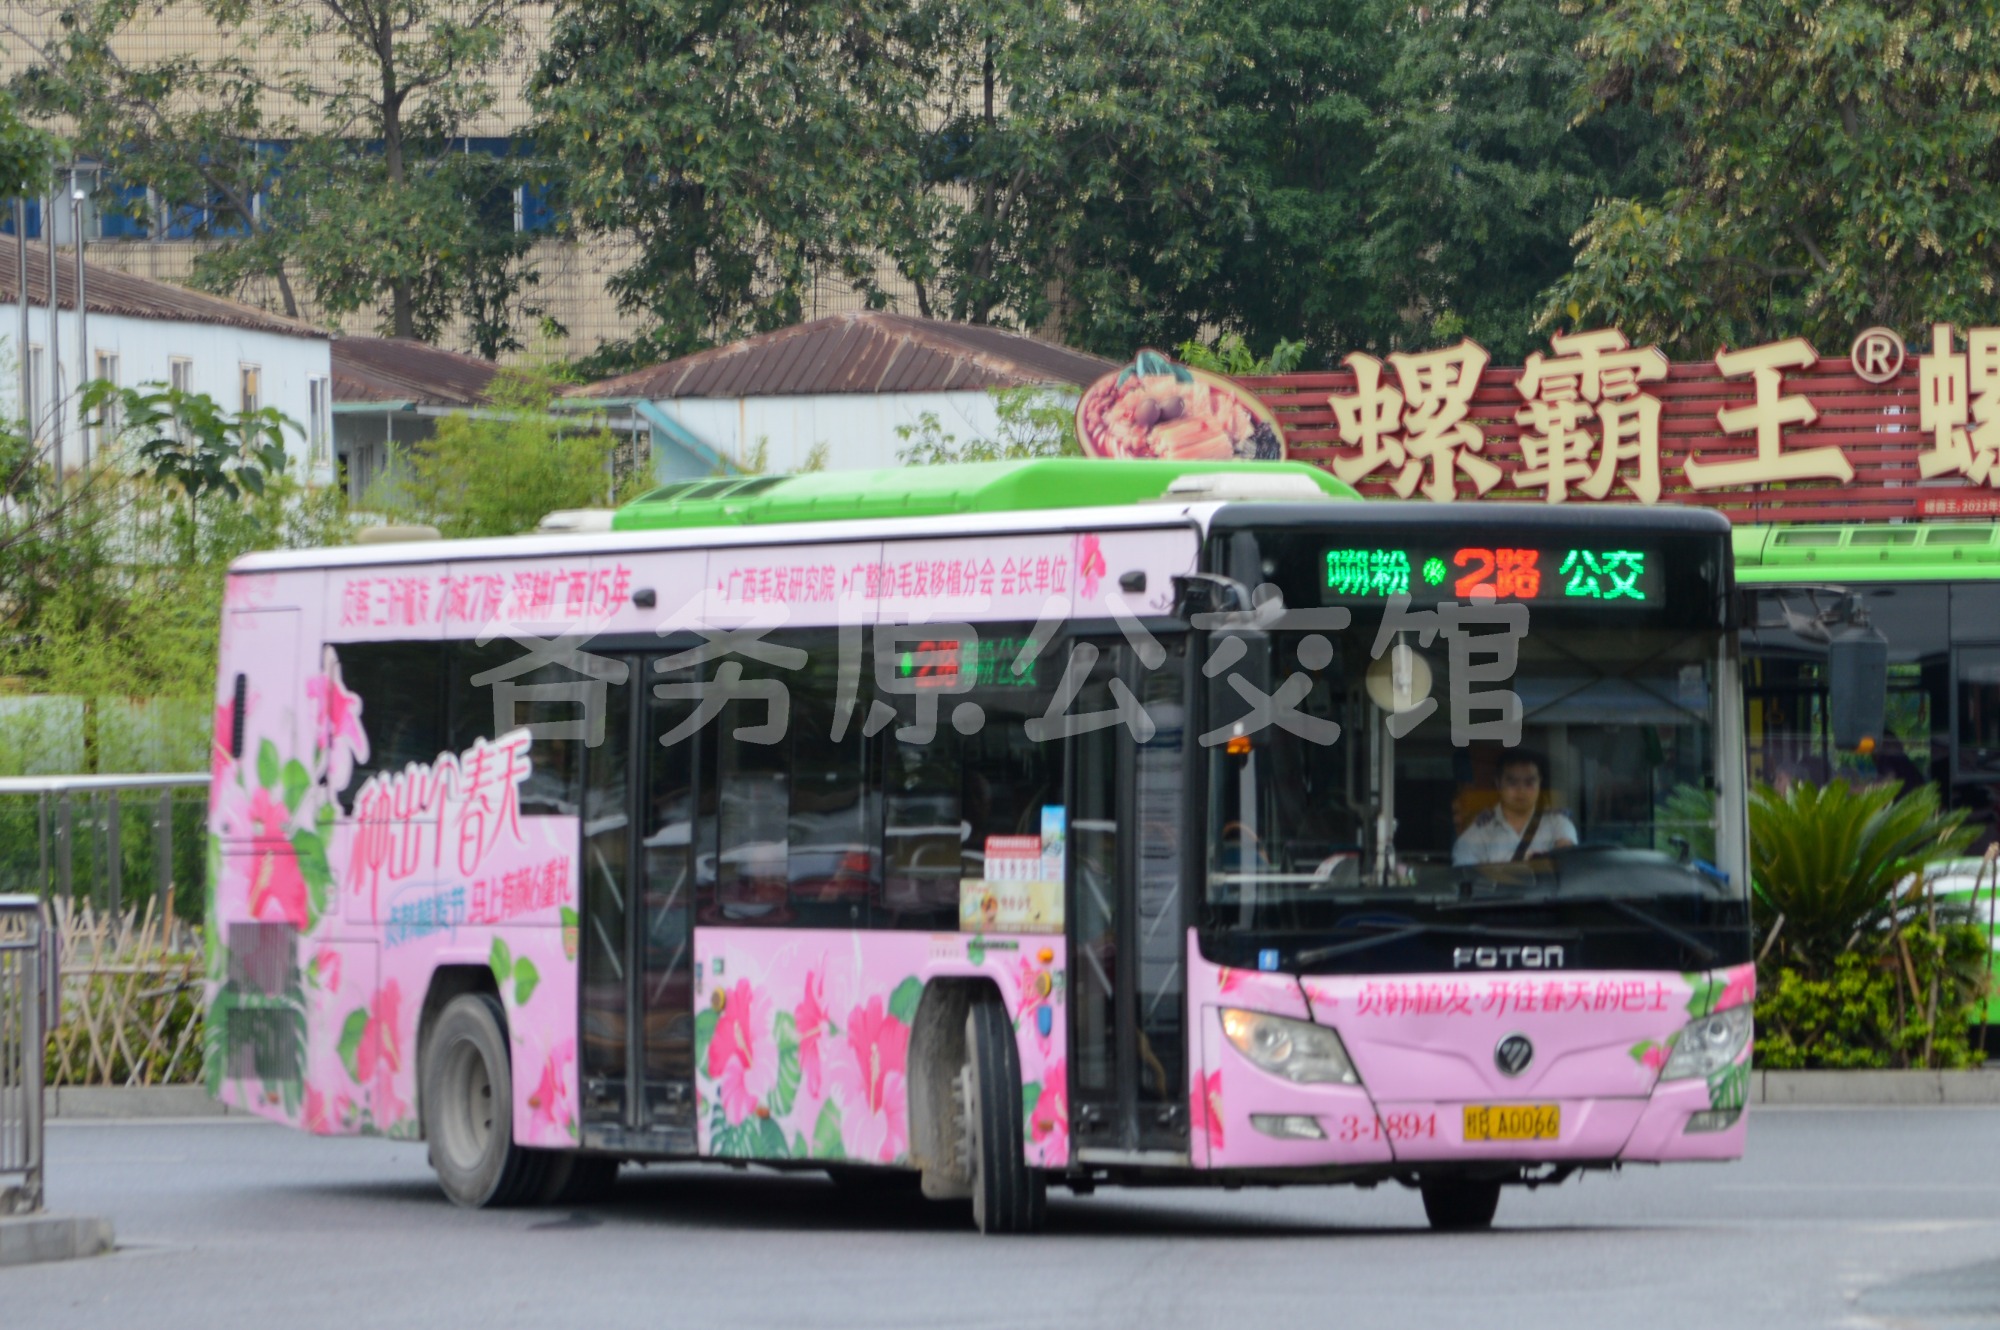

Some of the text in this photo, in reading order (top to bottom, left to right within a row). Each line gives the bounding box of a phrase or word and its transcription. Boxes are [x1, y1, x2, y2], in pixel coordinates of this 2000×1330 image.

[1327, 327, 1856, 504] 螺霸王
[1000, 553, 1067, 597] 会长单位
[1453, 548, 1541, 598] 2路
[1559, 550, 1646, 599] 公交
[1453, 945, 1564, 969] FOTON
[1339, 1111, 1437, 1142] 3-1894
[1498, 1109, 1558, 1136] A0066
